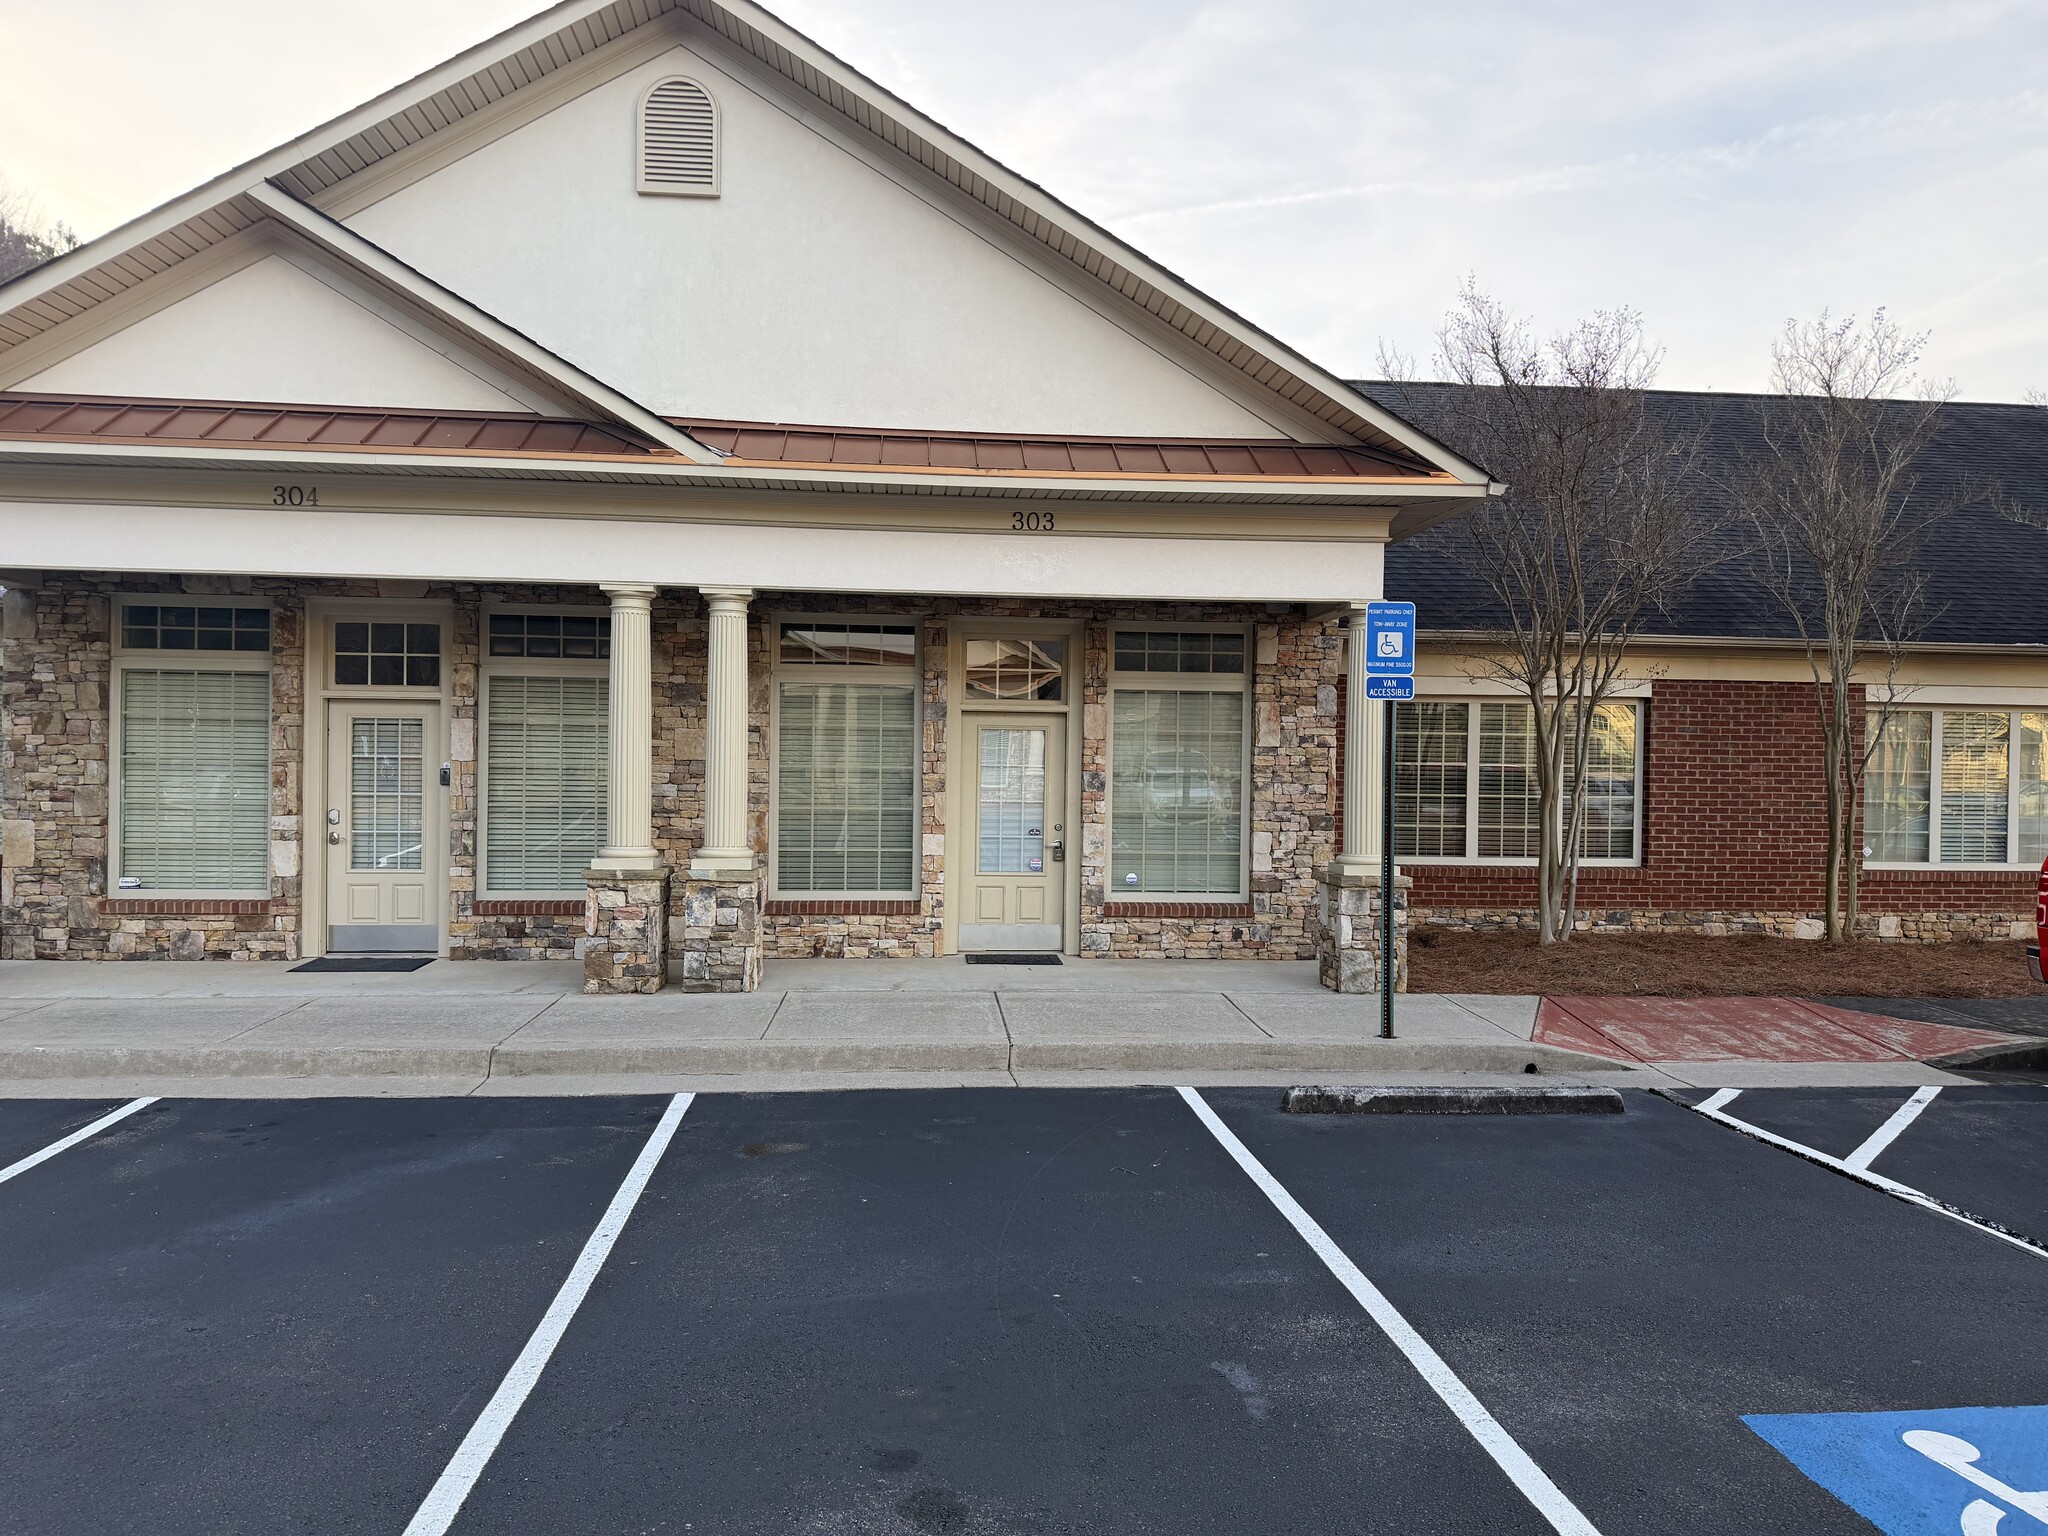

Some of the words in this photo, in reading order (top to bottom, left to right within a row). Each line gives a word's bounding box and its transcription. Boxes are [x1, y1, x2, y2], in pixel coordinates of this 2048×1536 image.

[272, 485, 319, 507] 304
[1012, 511, 1055, 531] 303
[1382, 679, 1397, 687] VAN
[1369, 688, 1411, 697] ACCESSIBLE
